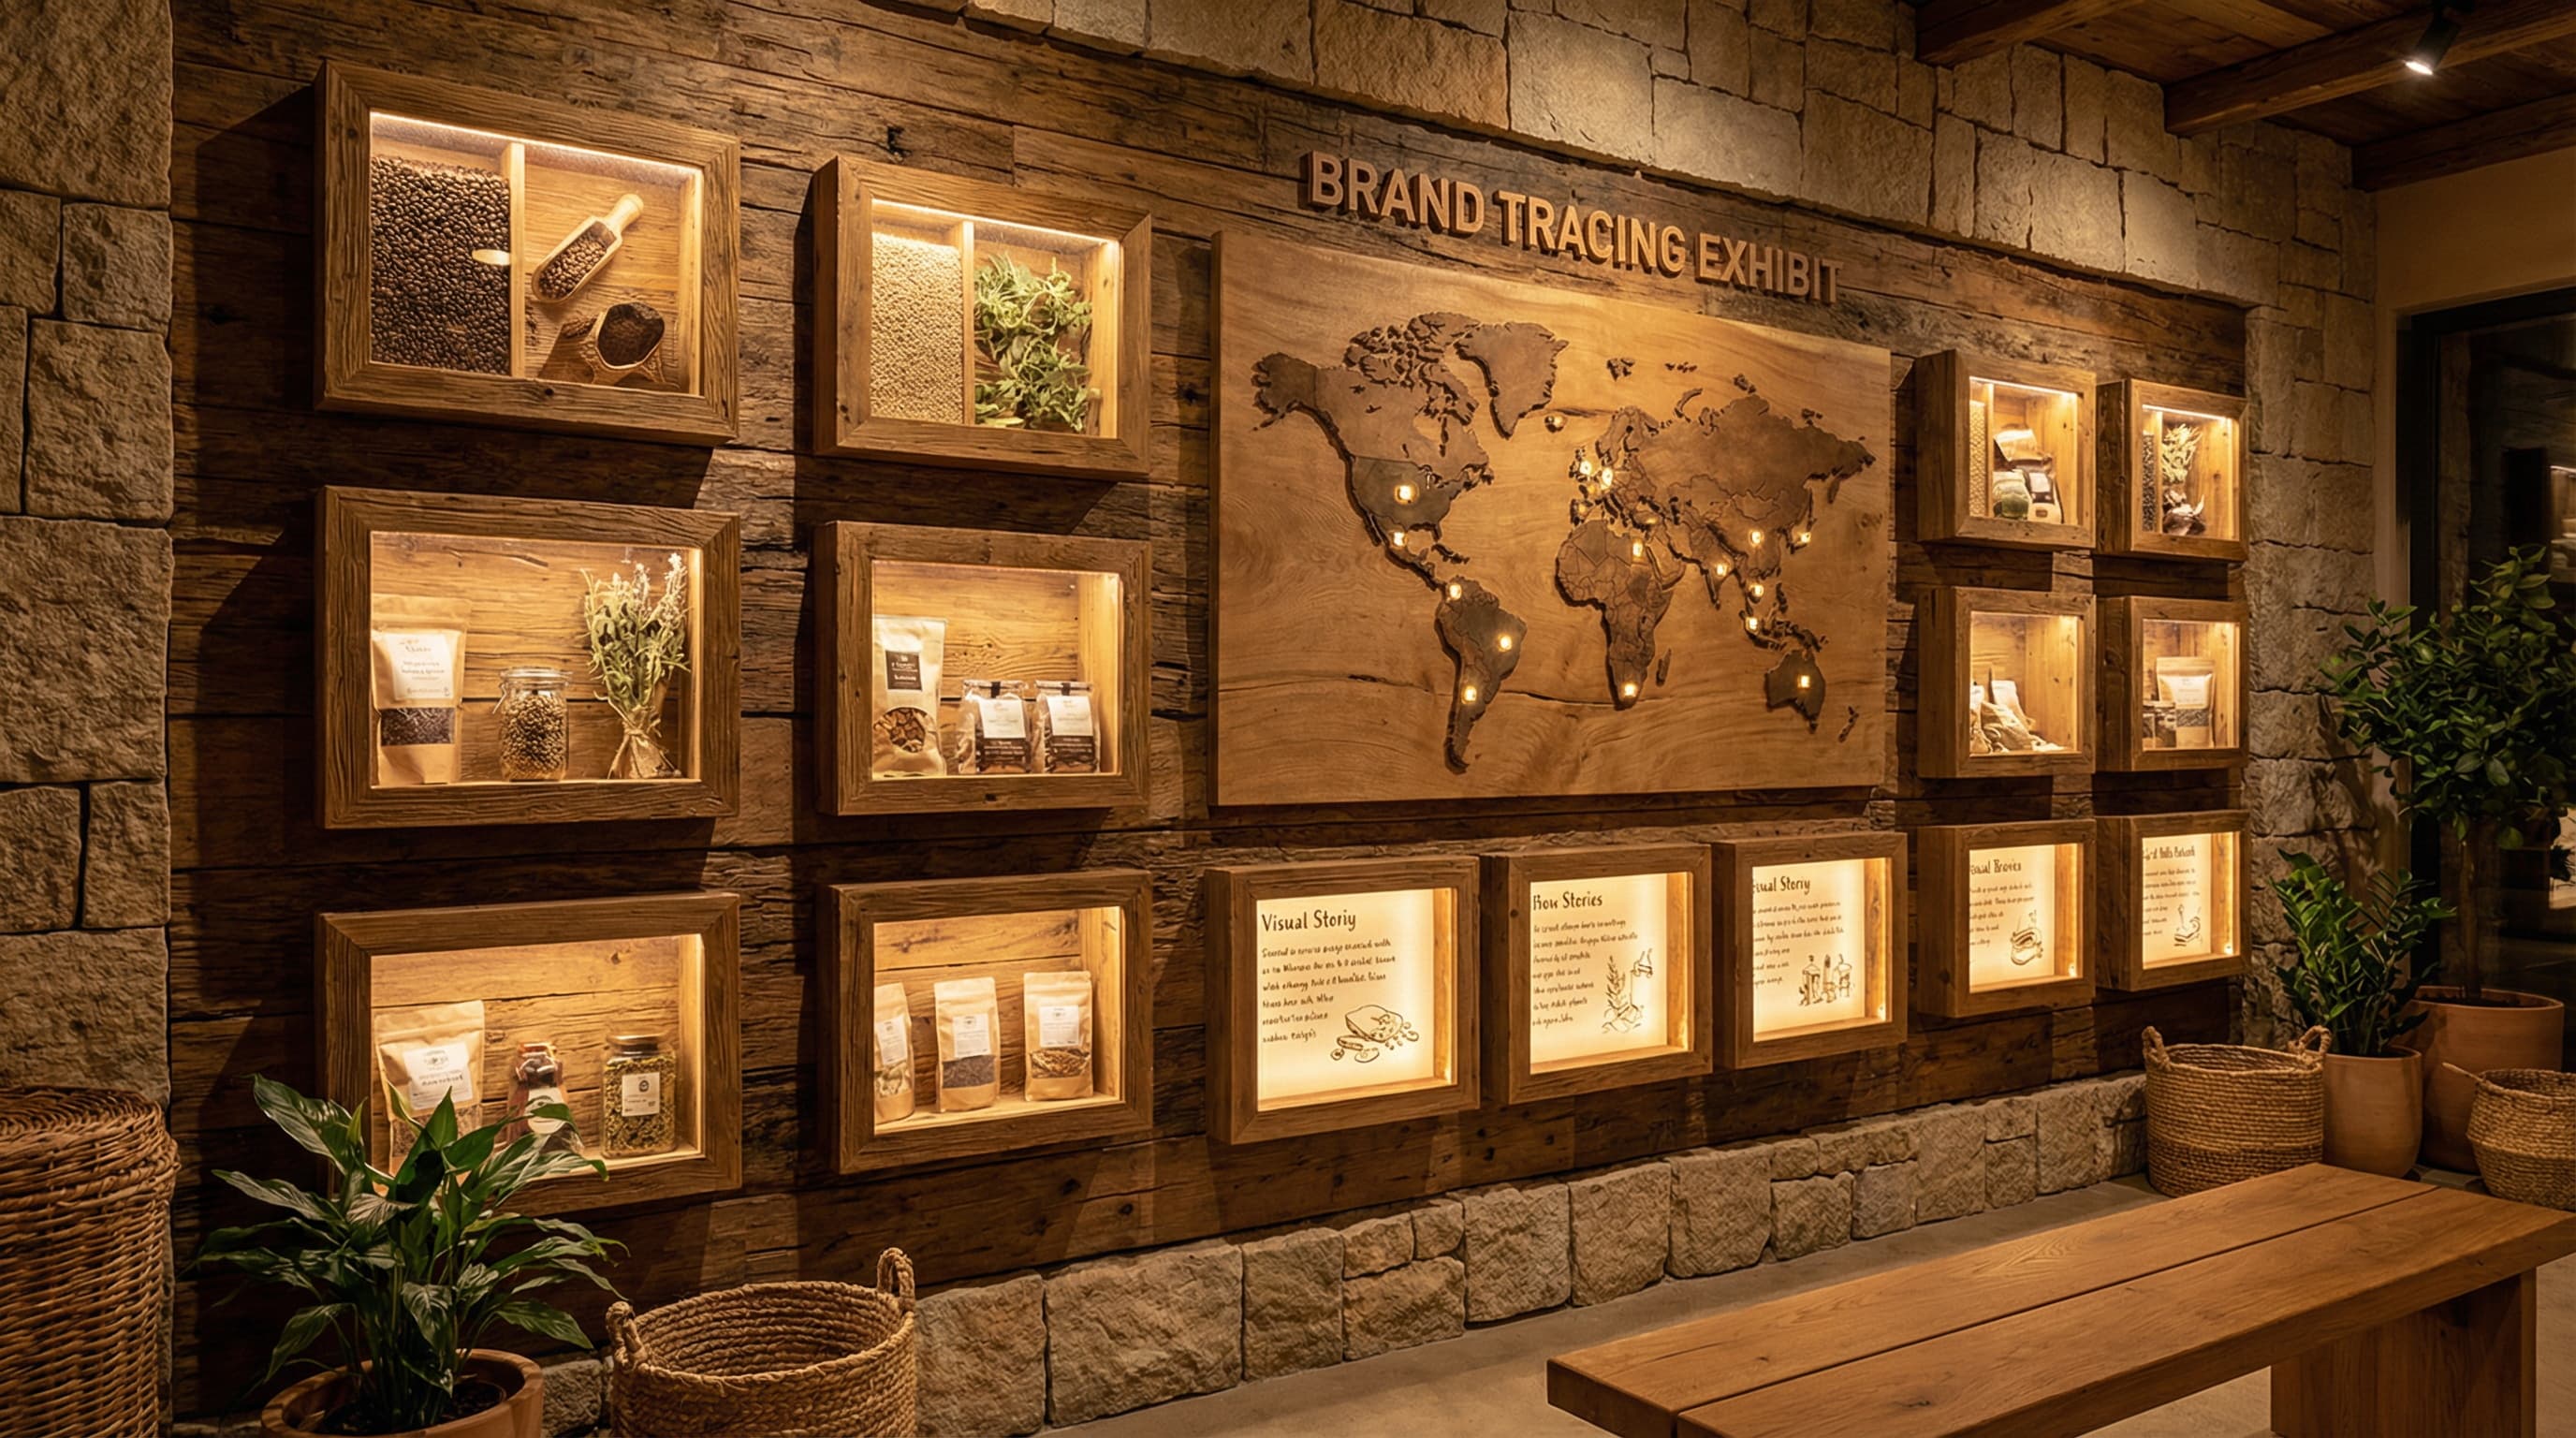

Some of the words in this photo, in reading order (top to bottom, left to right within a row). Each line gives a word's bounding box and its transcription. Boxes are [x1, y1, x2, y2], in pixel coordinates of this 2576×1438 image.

[1308, 150, 1486, 235] BRAND
[1498, 190, 1686, 275] TRACING
[1697, 232, 1844, 303] EXHIBIT
[1261, 911, 1309, 932] Visual
[1313, 908, 1357, 932] Storiy
